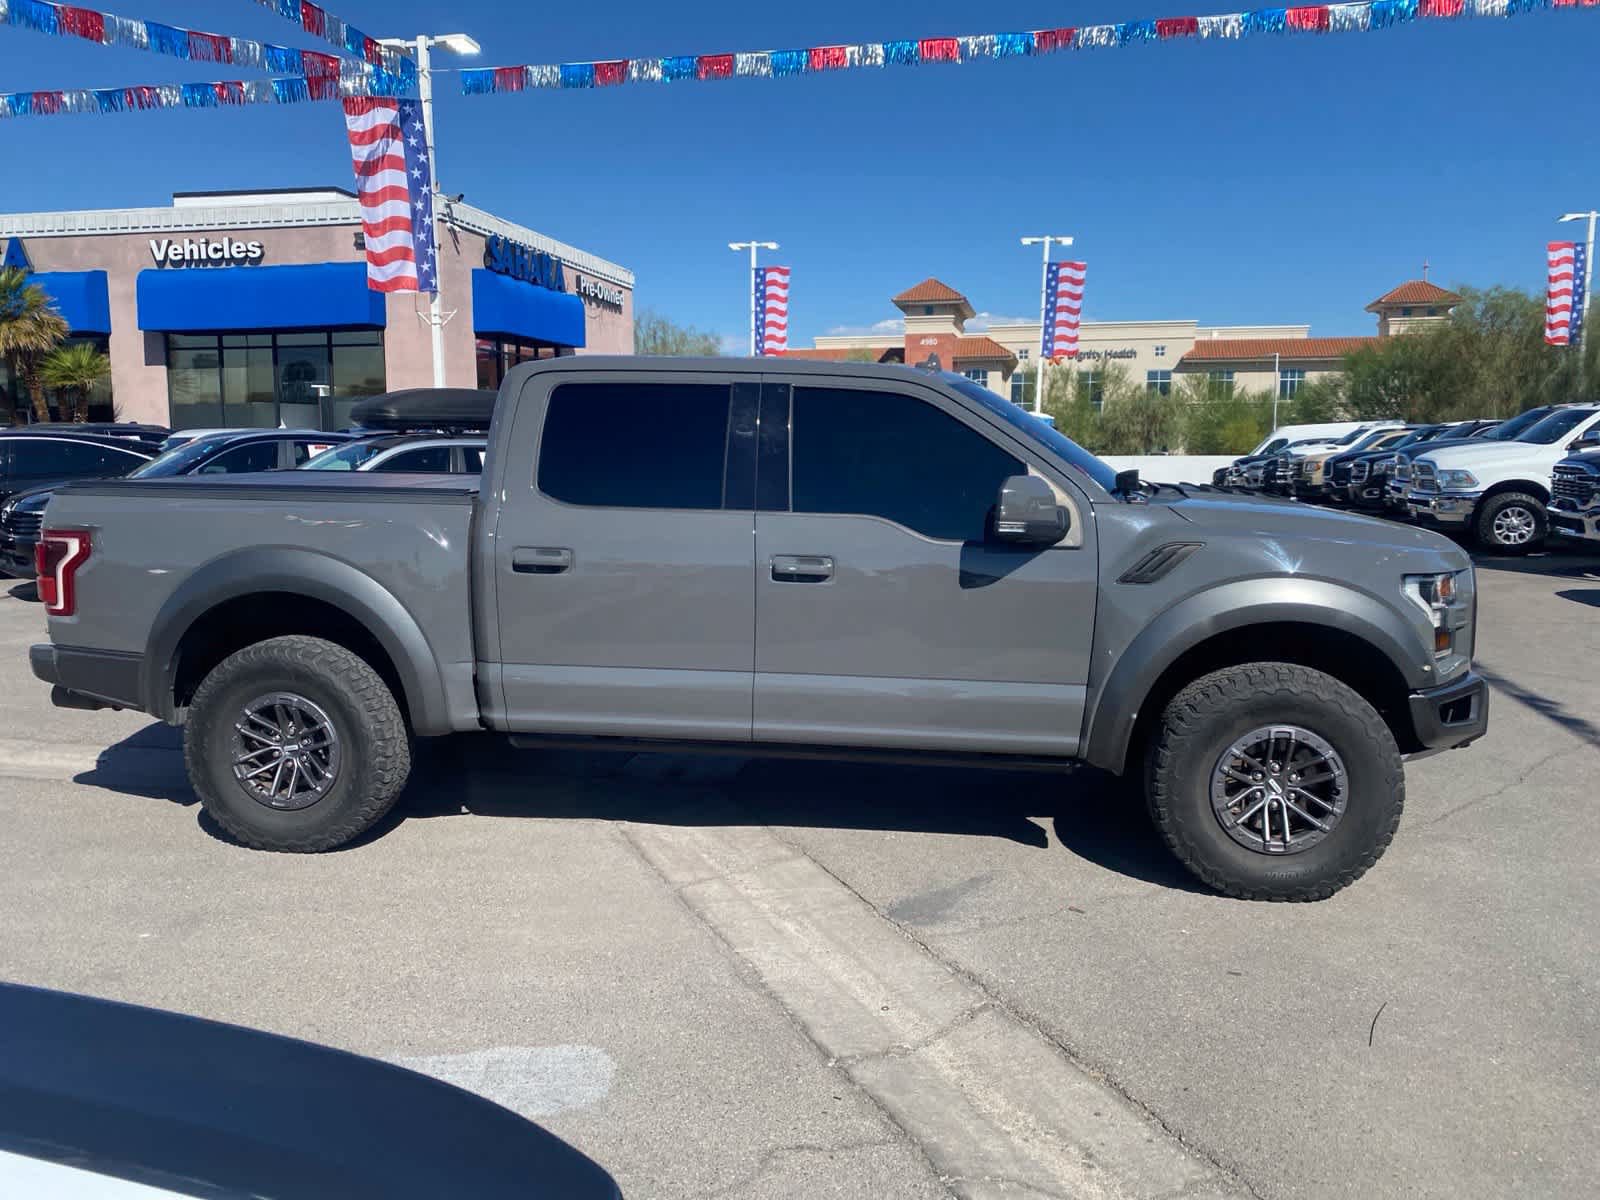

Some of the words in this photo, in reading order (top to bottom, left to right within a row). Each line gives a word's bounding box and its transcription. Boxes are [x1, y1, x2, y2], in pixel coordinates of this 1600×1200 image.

[148, 236, 262, 262] Vehicles
[487, 231, 567, 293] SAHARA
[580, 275, 625, 306] Pre-Owned
[1104, 348, 1137, 360] Health
